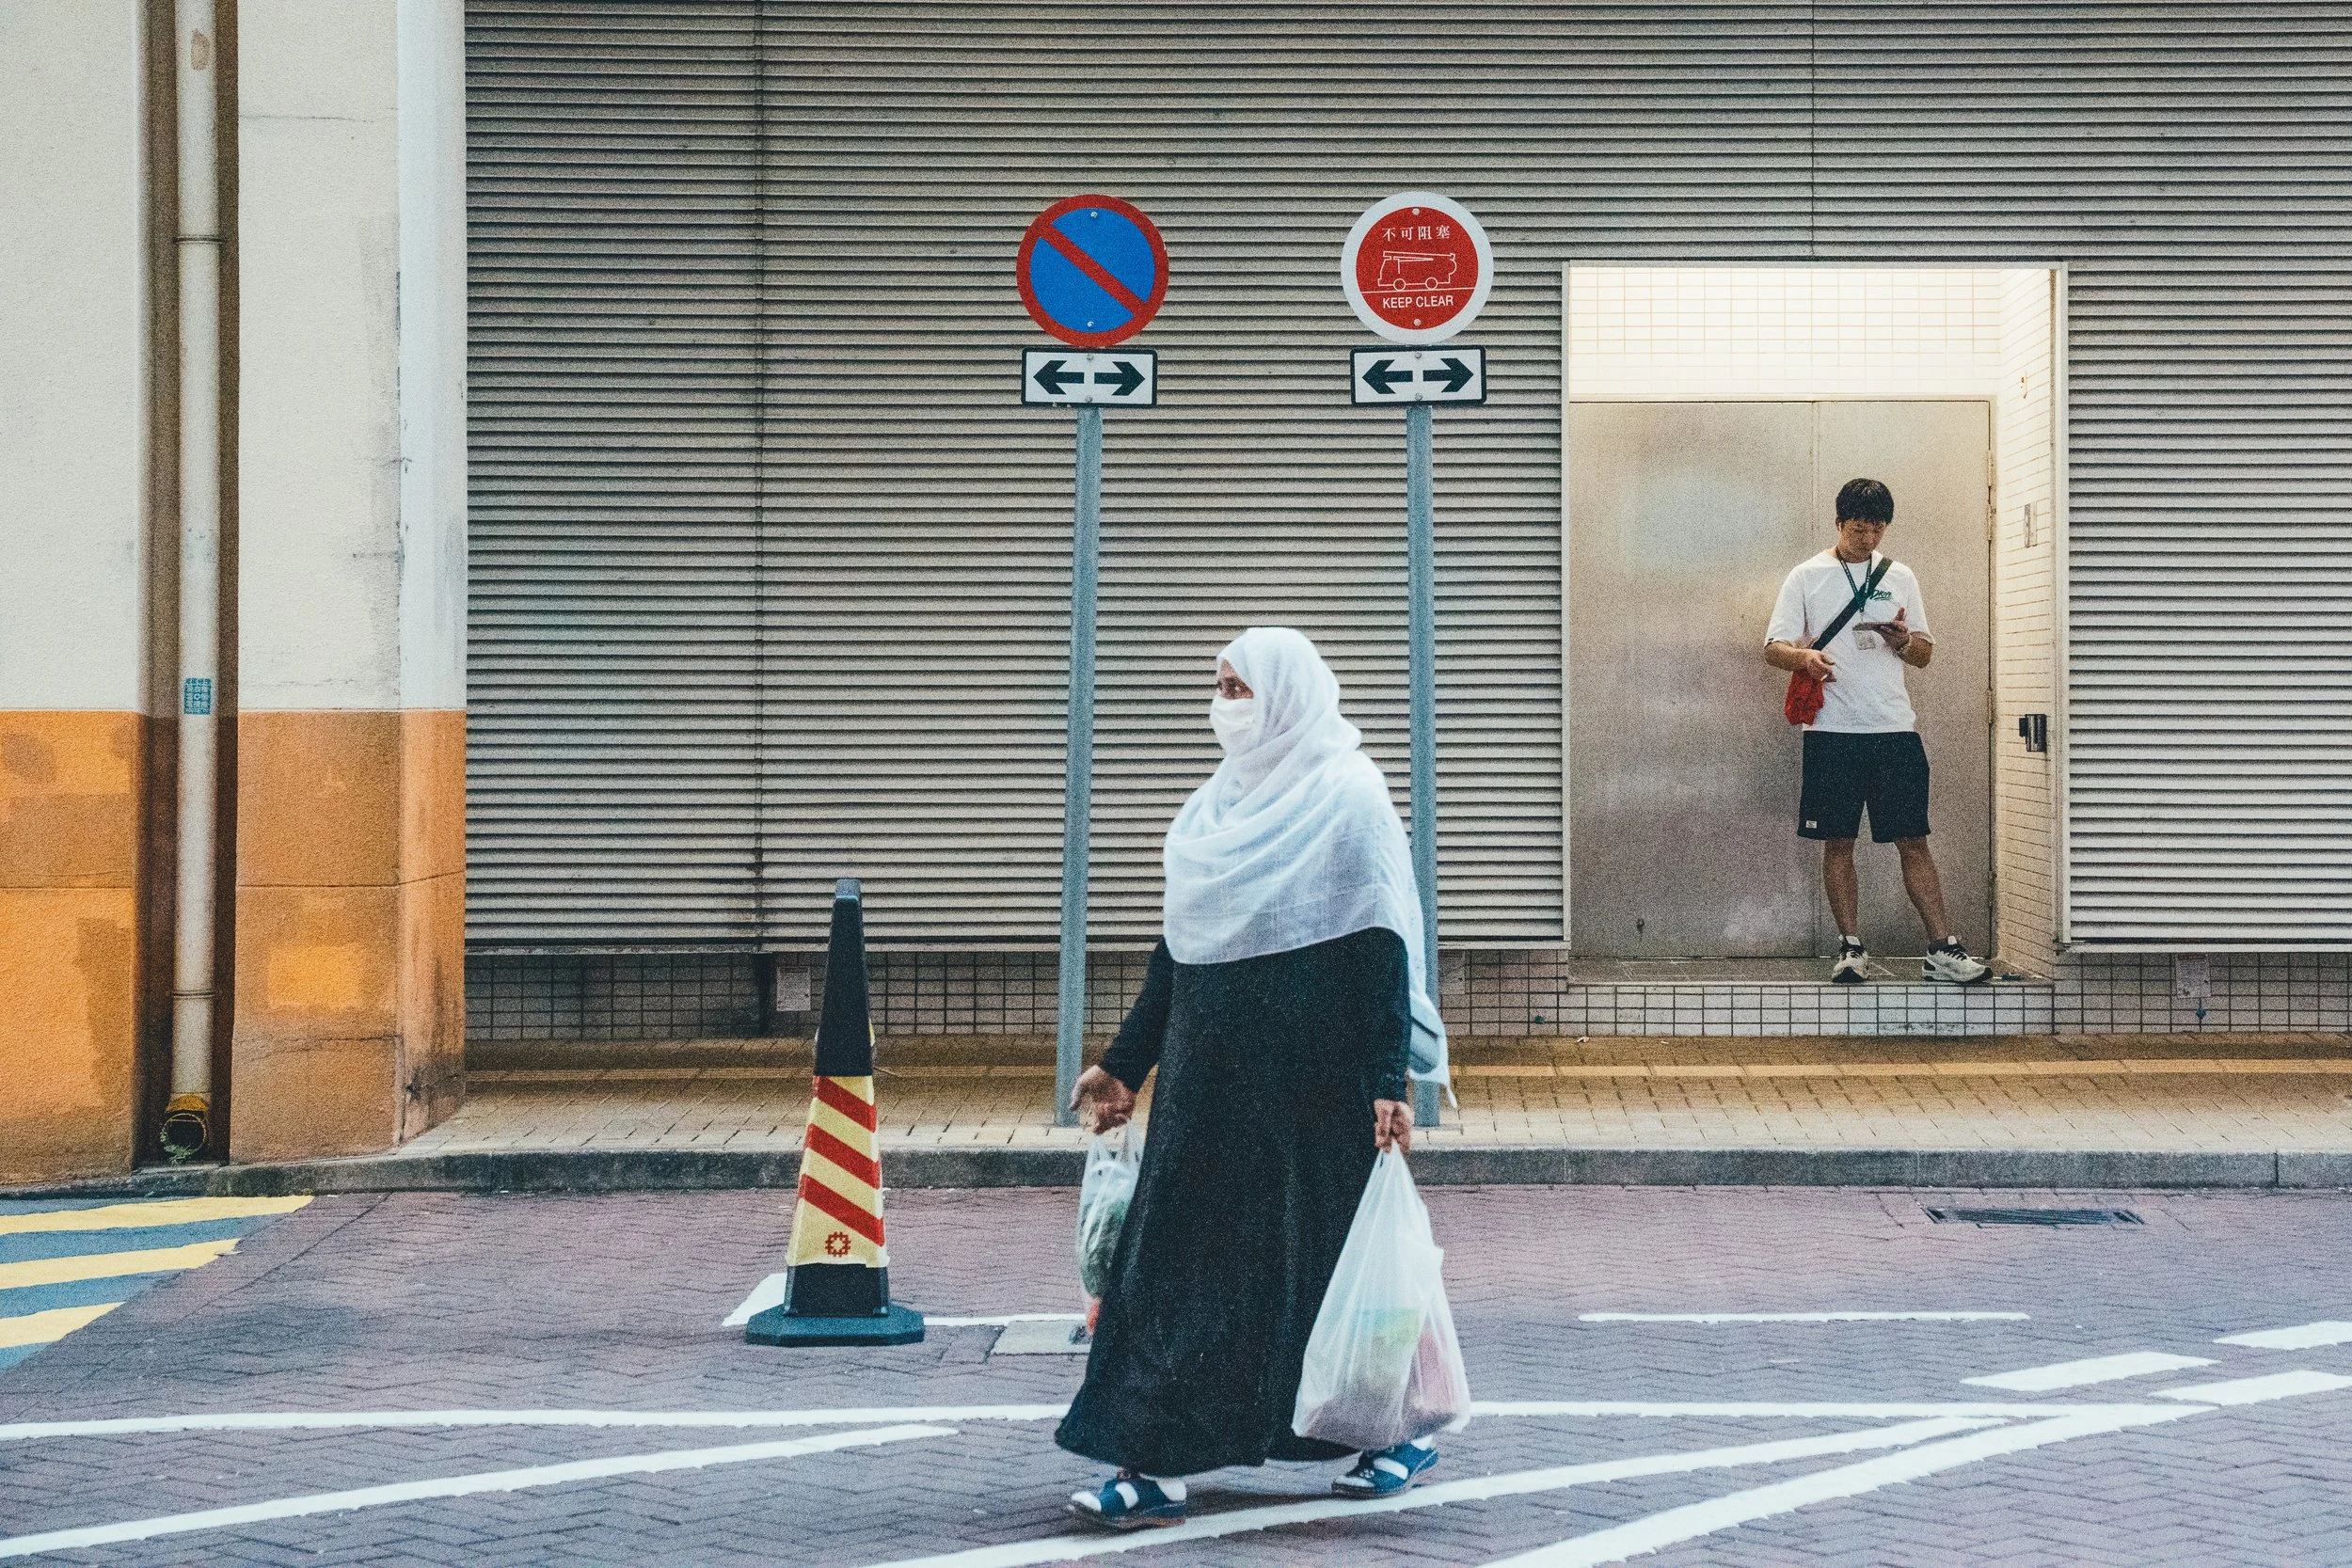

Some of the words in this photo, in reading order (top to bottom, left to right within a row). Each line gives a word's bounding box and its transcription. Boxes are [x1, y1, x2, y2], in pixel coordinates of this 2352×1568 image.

[1382, 225, 1450, 241] 不可阻塞
[1383, 297, 1412, 309] KEEP
[1416, 295, 1454, 307] CLEAR
